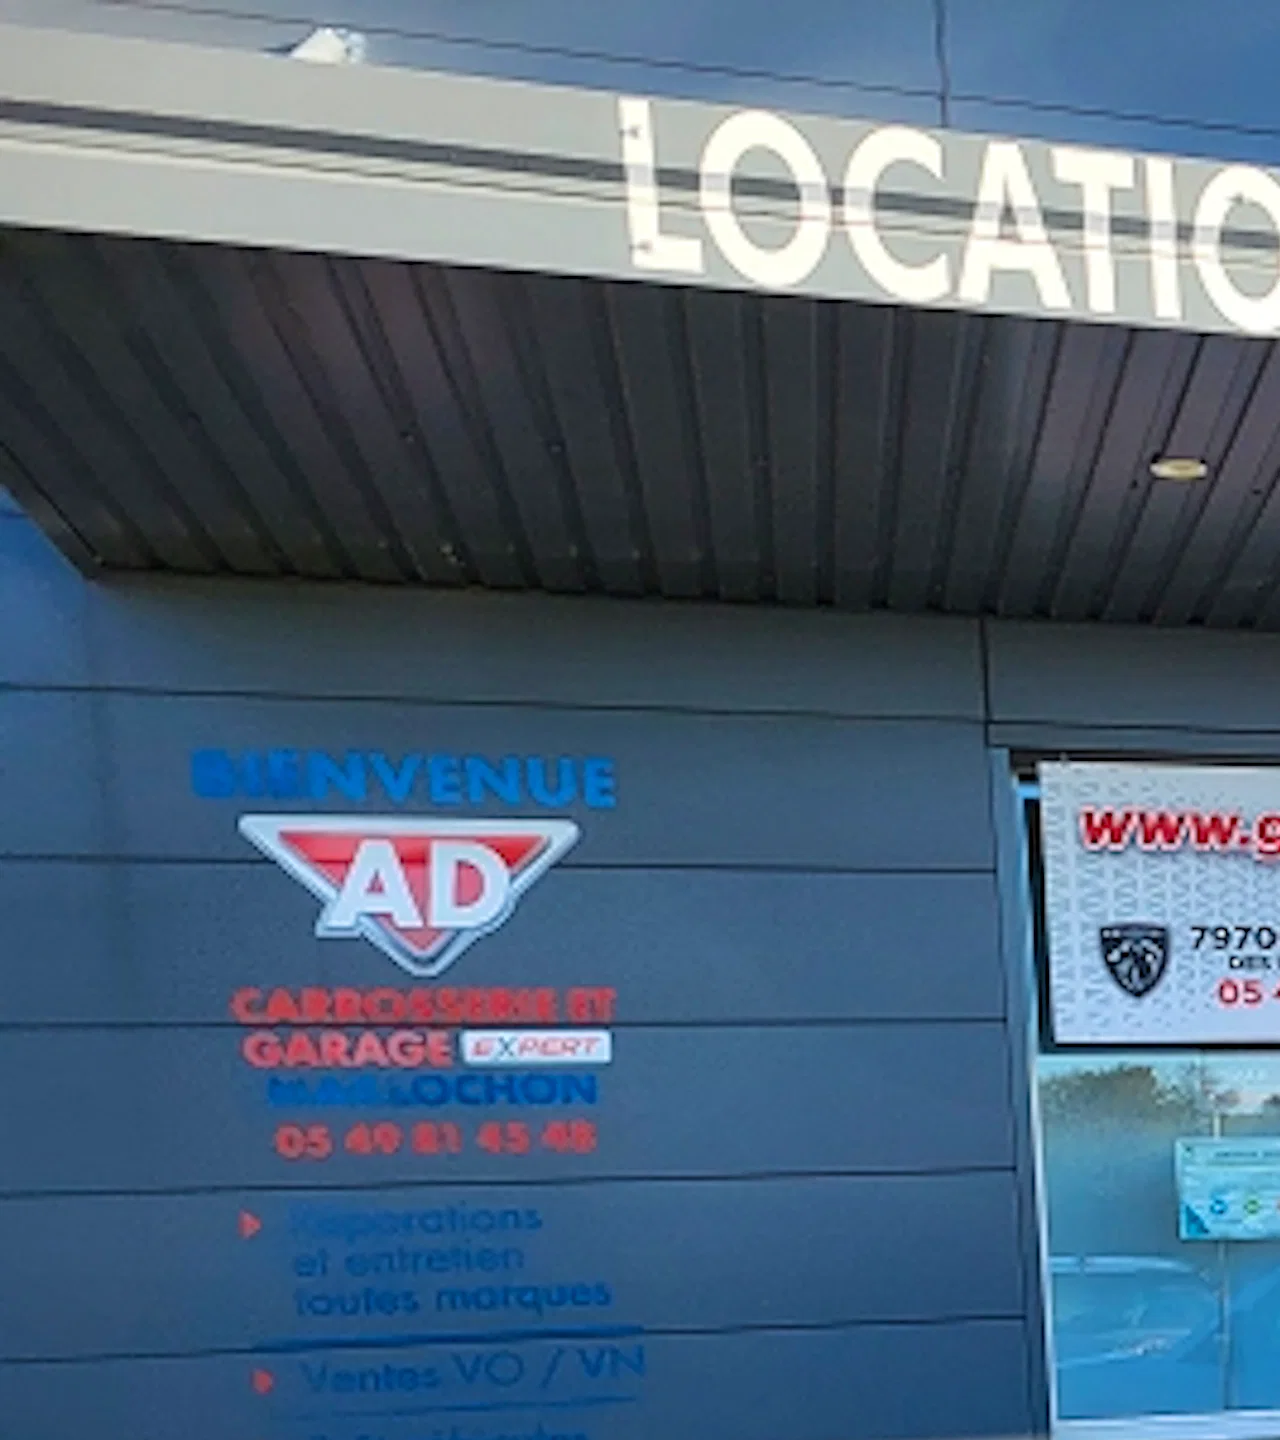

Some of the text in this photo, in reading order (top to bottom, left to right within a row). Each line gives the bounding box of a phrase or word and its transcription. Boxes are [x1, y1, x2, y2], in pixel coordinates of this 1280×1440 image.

[190, 748, 617, 809] BIENVENUE
[326, 838, 511, 929] AD
[228, 985, 618, 1024] CARROSSERIE ET
[1218, 979, 1263, 1005] 05
[241, 1030, 603, 1069] GARAGE EXPERT
[274, 1121, 335, 1161] 05
[343, 1119, 404, 1155] 49
[344, 1241, 525, 1277] entretien
[295, 1280, 613, 1317] toutes marques
[300, 1360, 442, 1394] Ventes
[452, 1349, 525, 1388] VO
